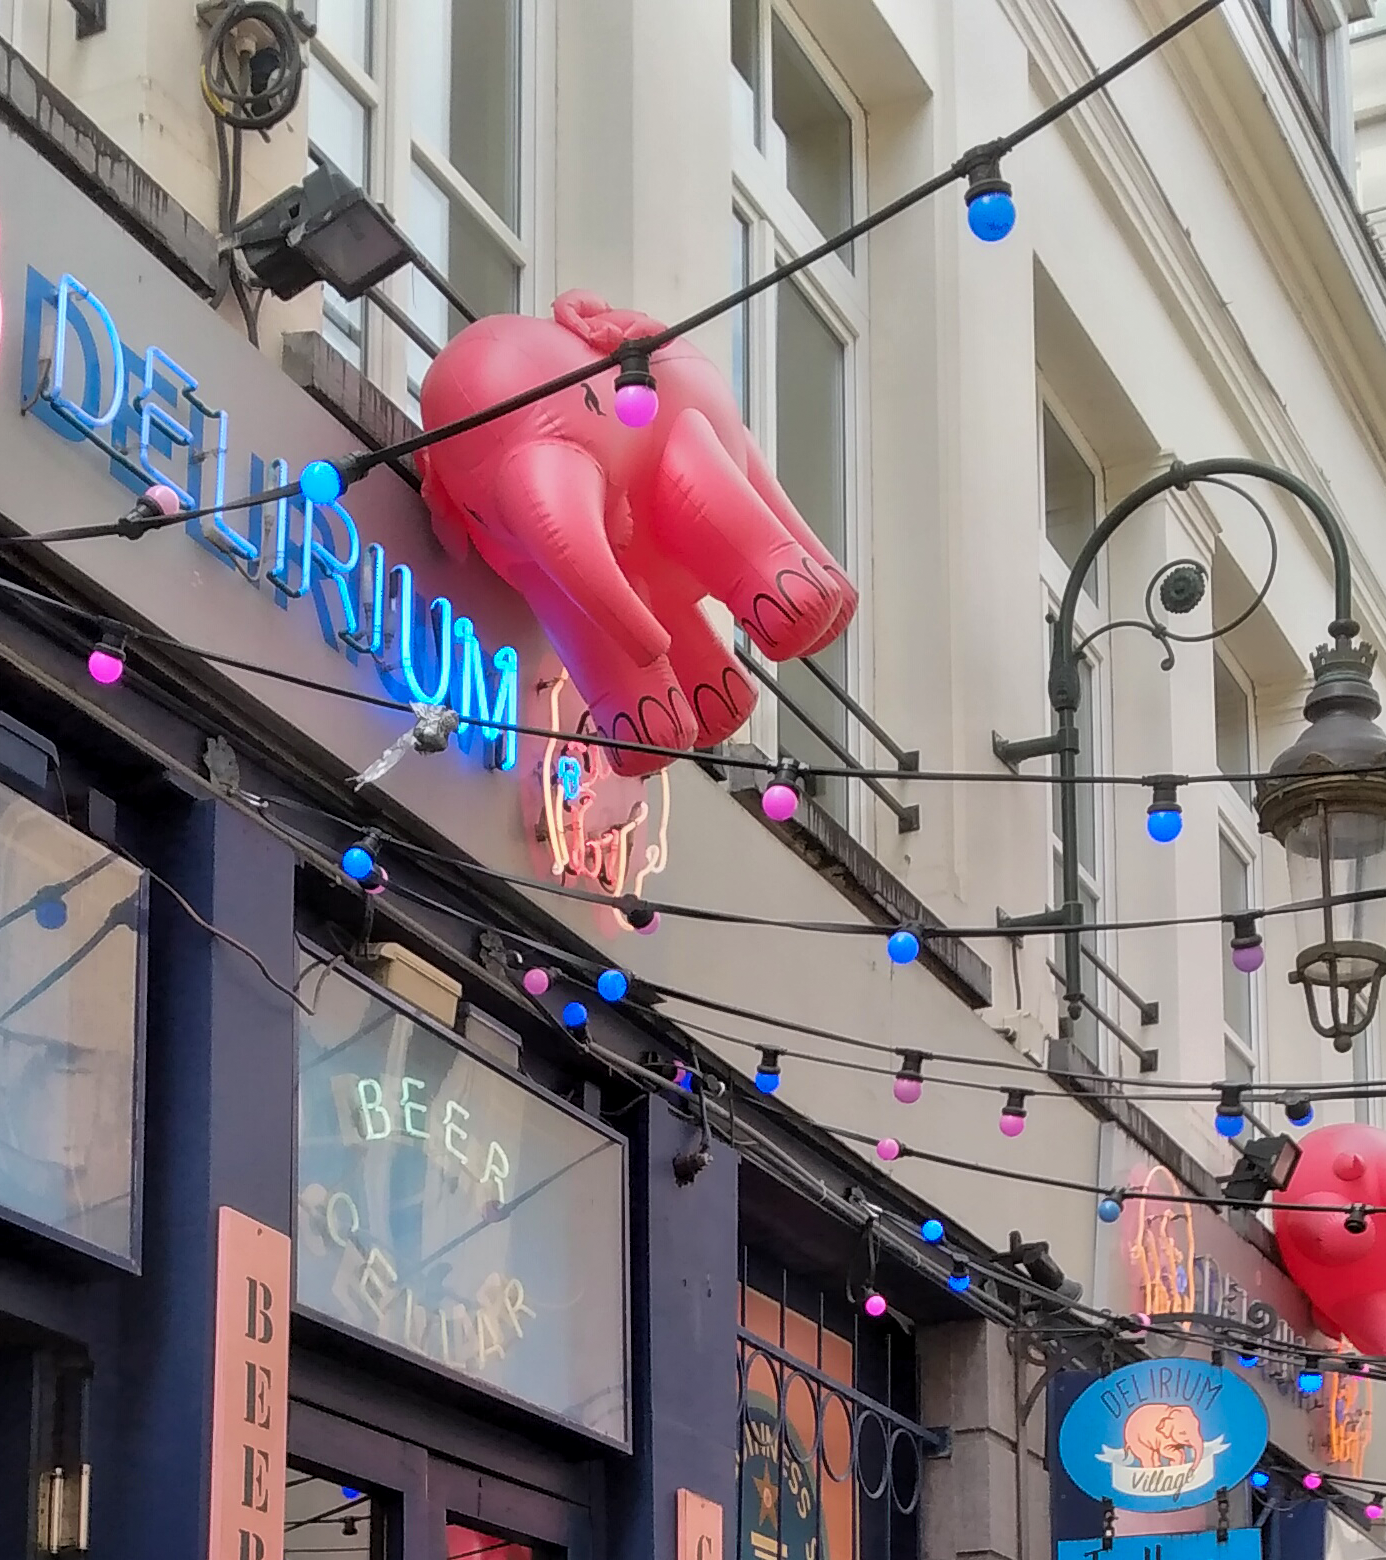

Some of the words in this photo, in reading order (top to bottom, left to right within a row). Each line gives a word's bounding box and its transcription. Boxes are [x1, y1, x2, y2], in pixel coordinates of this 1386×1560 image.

[25, 265, 518, 772] DELIRIUM
[357, 1076, 511, 1206] BEER
[1099, 1366, 1223, 1421] DELIRIUM
[1129, 1467, 1197, 1503] Village
